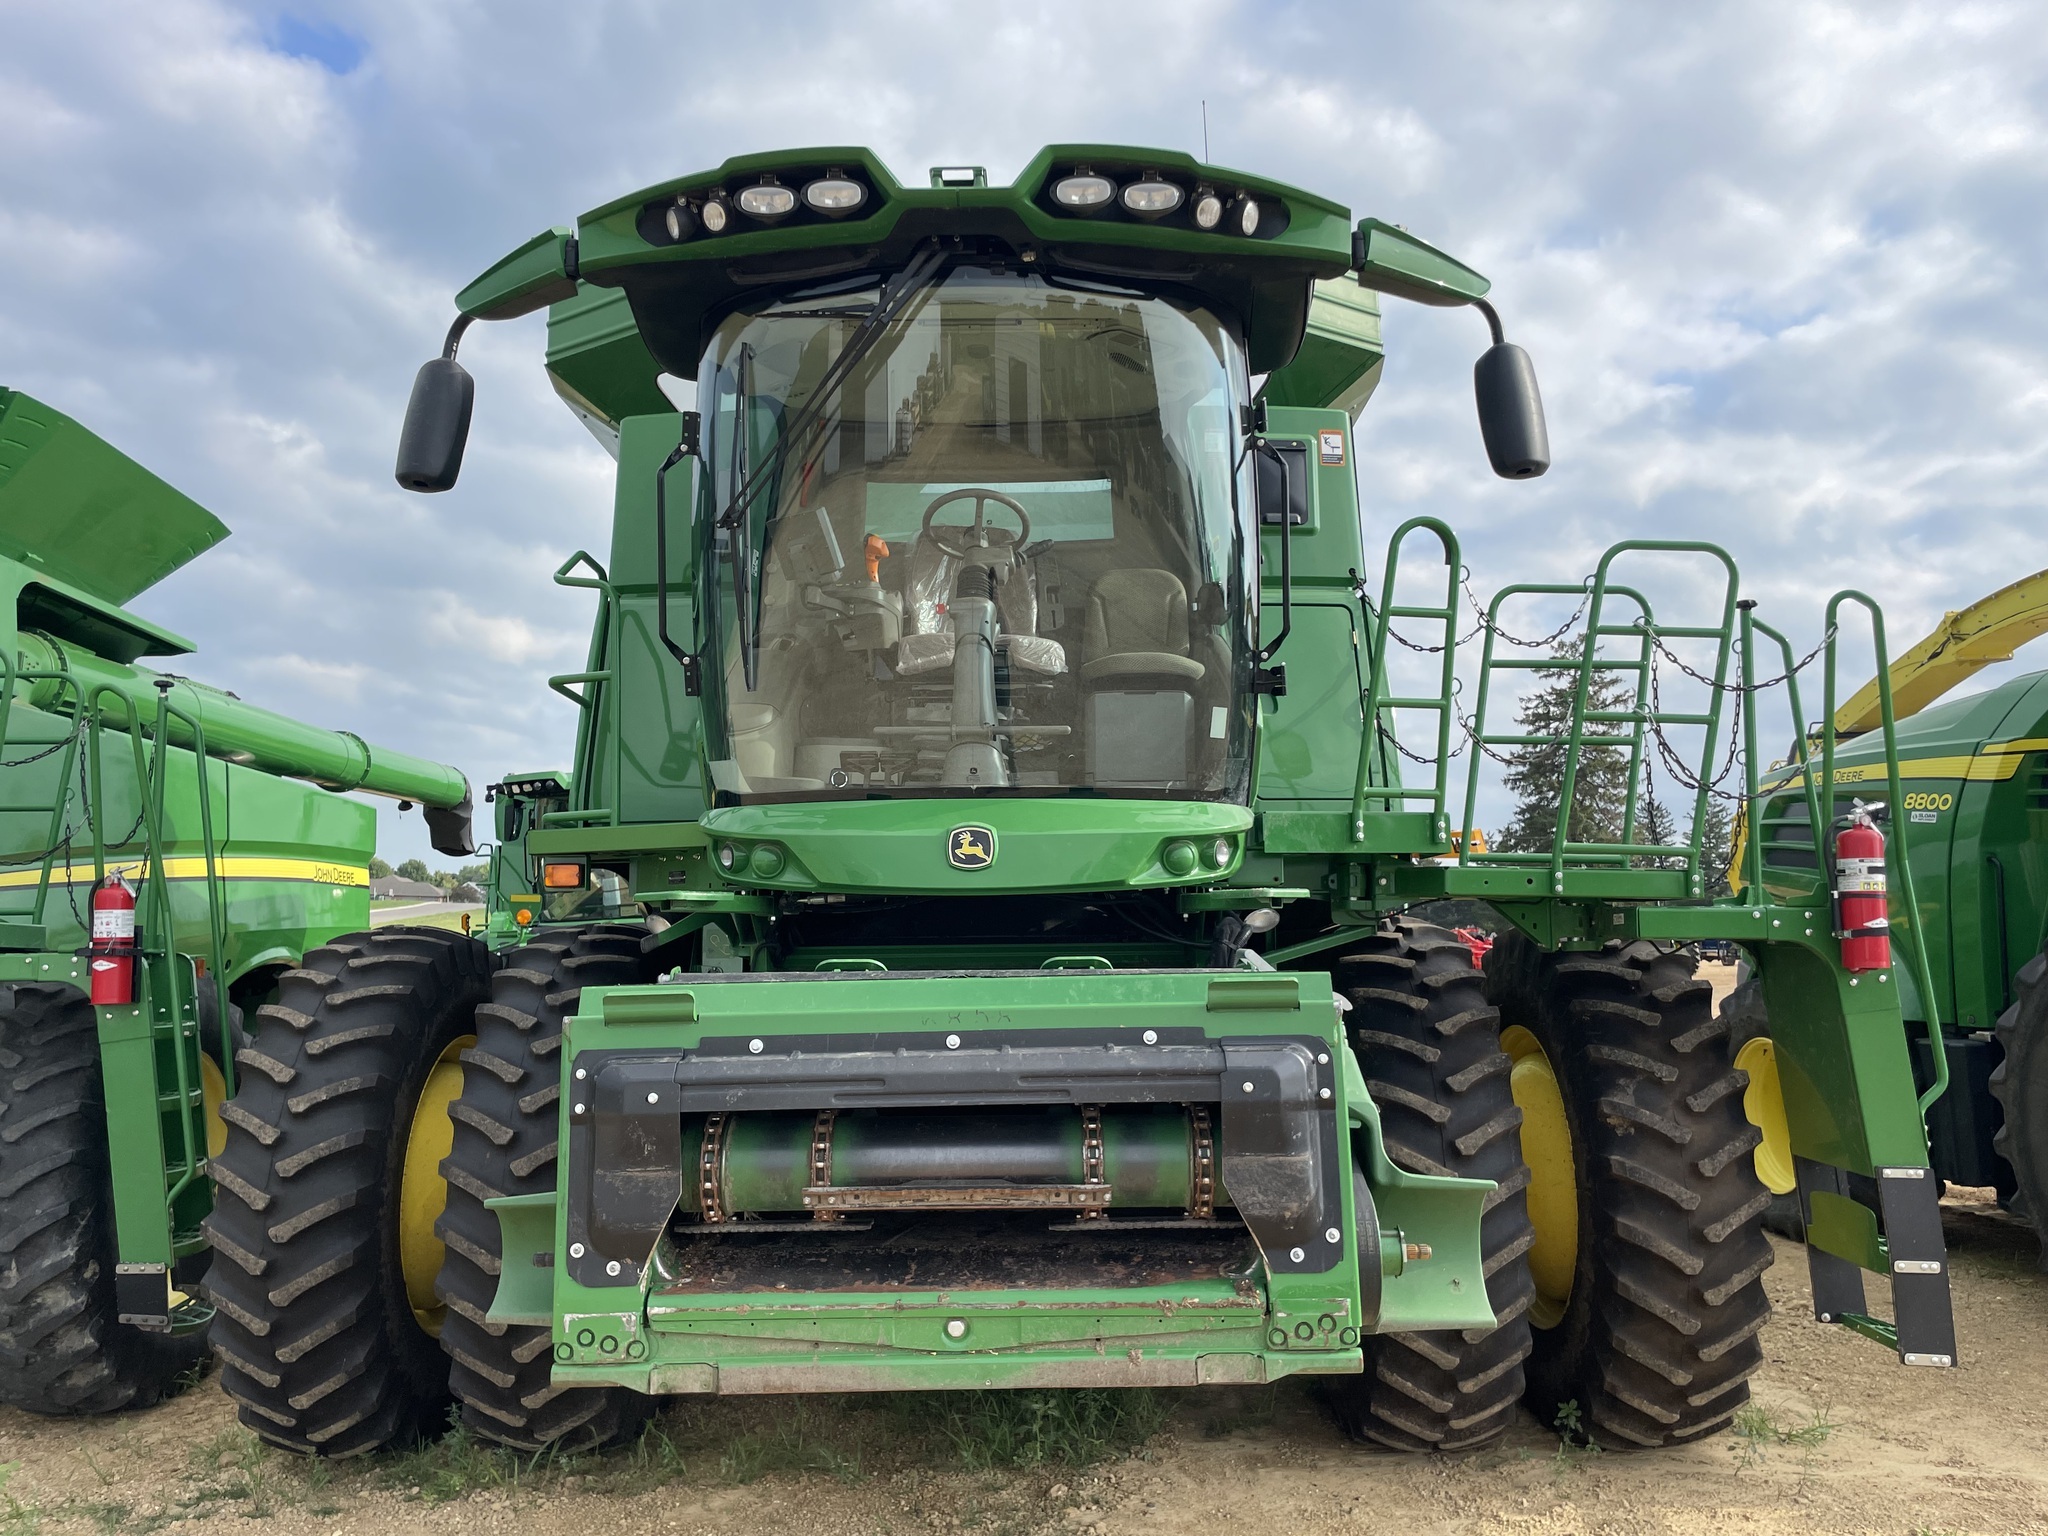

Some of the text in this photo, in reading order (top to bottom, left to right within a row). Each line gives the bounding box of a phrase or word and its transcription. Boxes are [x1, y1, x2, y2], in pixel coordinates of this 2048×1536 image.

[1834, 770, 1864, 782] DEERE
[1903, 792, 1953, 811] 8800
[314, 865, 355, 883] JOHN DEERE
